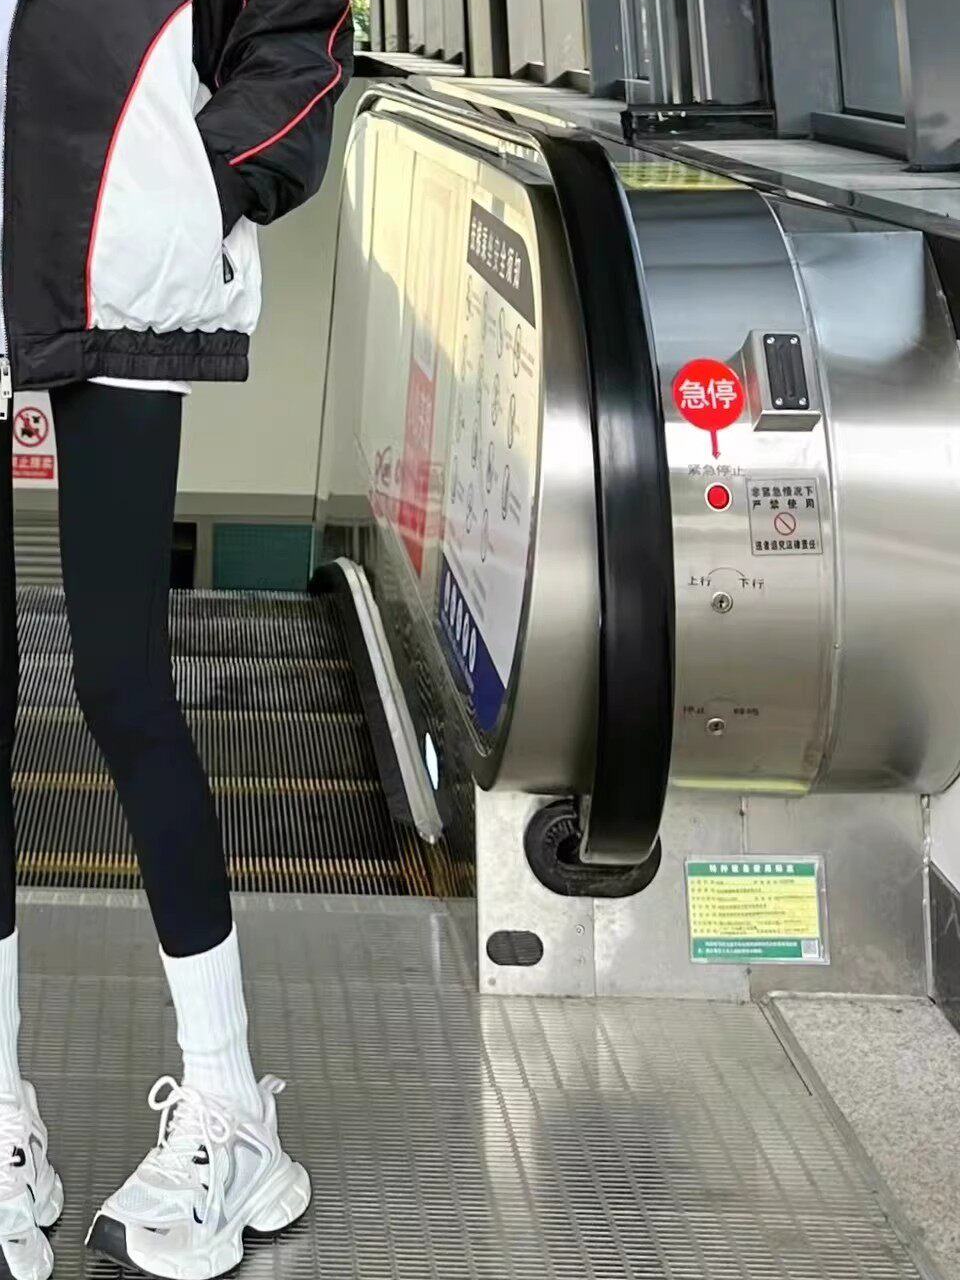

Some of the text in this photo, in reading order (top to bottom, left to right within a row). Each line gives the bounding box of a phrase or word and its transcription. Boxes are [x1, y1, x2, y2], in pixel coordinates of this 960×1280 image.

[679, 378, 737, 409] 急停
[688, 464, 745, 477] 紧急停止
[688, 575, 711, 587] 上行
[739, 577, 764, 589] 下行
